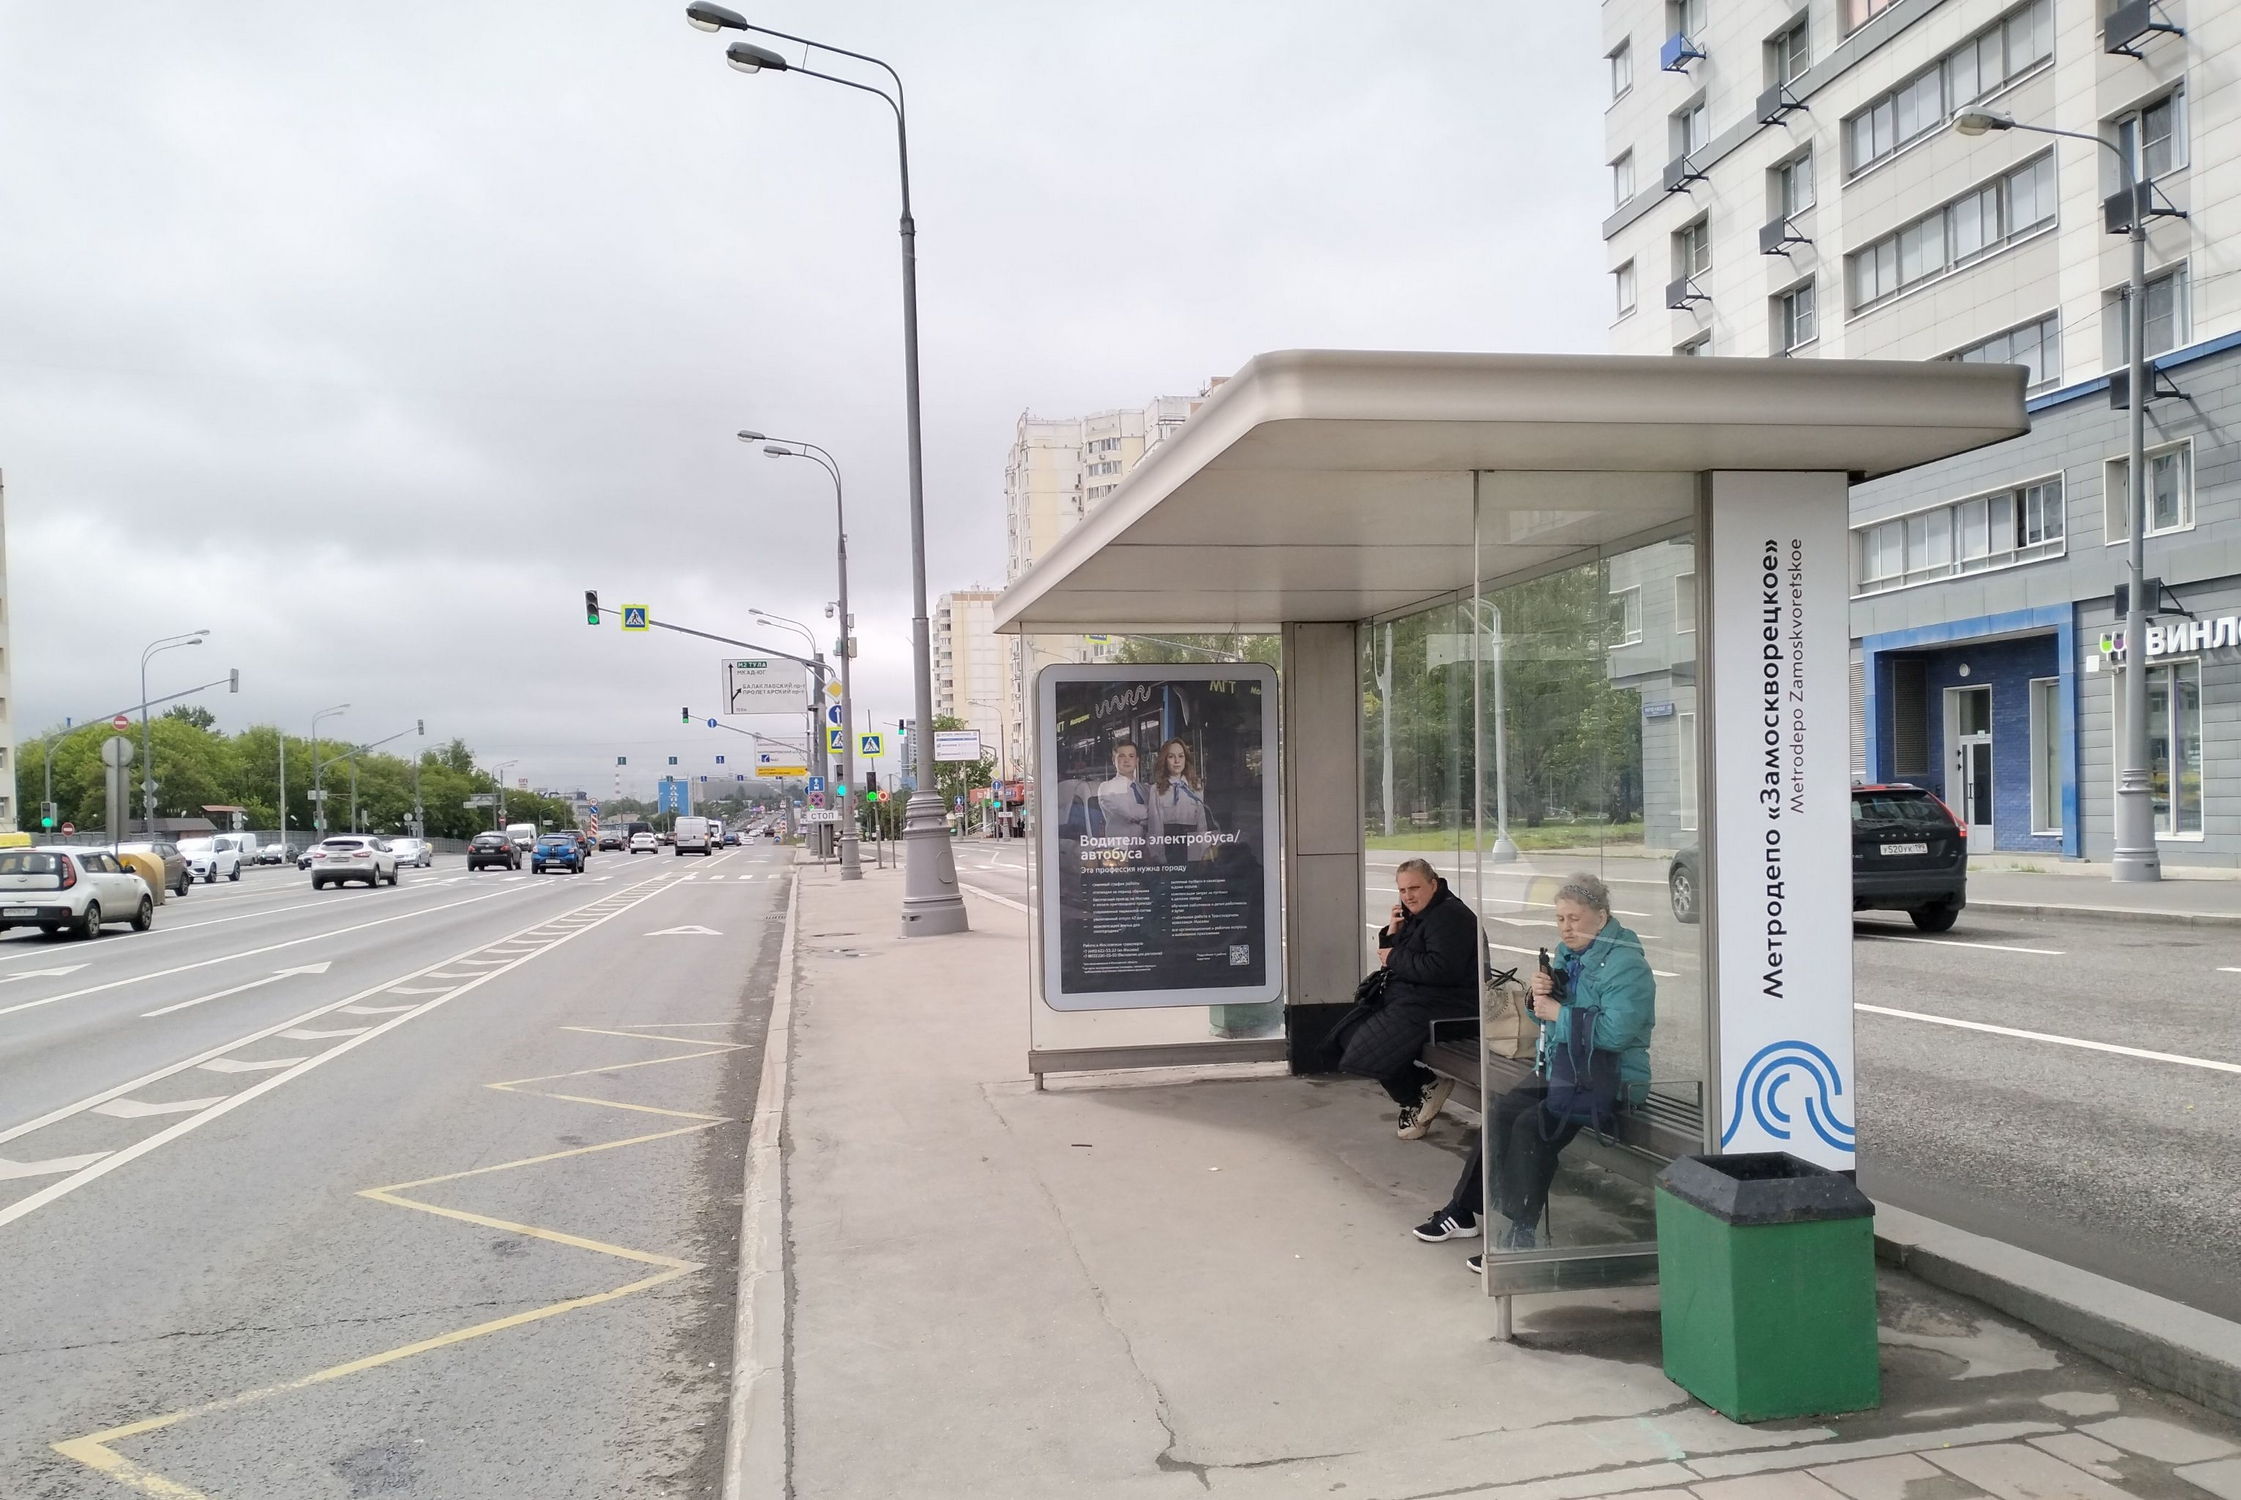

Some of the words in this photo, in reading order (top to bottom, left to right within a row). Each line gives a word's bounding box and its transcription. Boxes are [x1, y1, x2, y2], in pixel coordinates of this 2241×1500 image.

[1787, 538, 1804, 702] Zamoskvoretskoe
[2146, 616, 2241, 656] ВИНЛ
[1760, 538, 1783, 820] «Замоскворецкое»
[1789, 707, 1807, 814] Metrodepo
[810, 812, 834, 820] СТОП
[1080, 834, 1146, 848] Водитель
[1149, 829, 1241, 846] электробуса/
[1080, 848, 1142, 861] автобуса
[1095, 866, 1136, 875] профессия
[1137, 865, 1160, 874] нужна
[1161, 865, 1187, 873] городу
[1763, 830, 1787, 999] Метродепо
